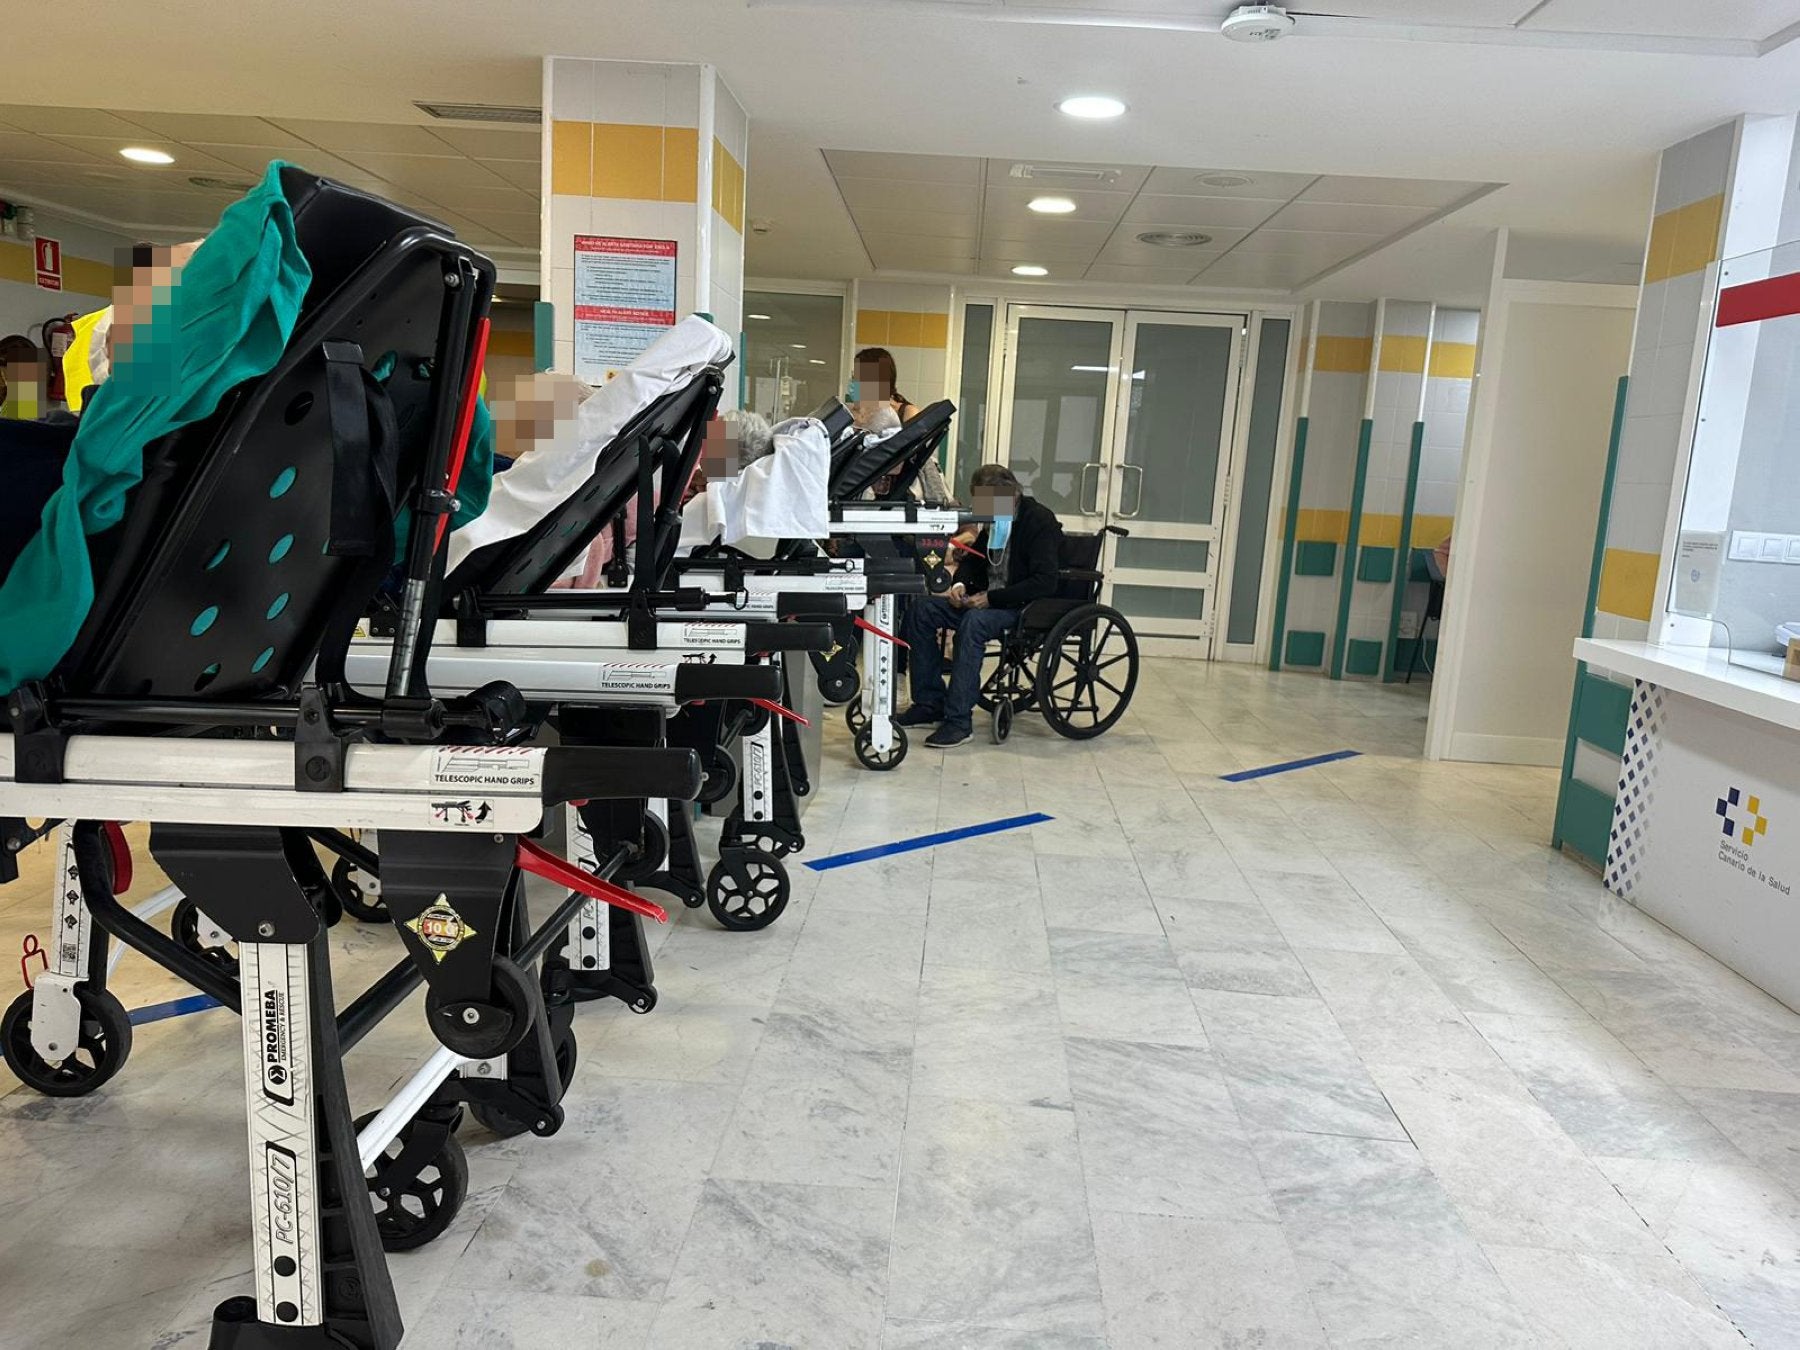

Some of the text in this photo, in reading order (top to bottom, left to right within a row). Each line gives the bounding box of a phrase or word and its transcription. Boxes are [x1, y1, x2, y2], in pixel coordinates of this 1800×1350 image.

[435, 774, 535, 785] TELESCOPIC HAND GRIPS
[1719, 839, 1749, 861] Servicio
[1718, 851, 1791, 896] Canario de la Salud
[264, 989, 278, 1063] PROMEBA
[279, 1023, 287, 1061] EMERGENCY
[272, 1152, 295, 1245] PC-610/7
